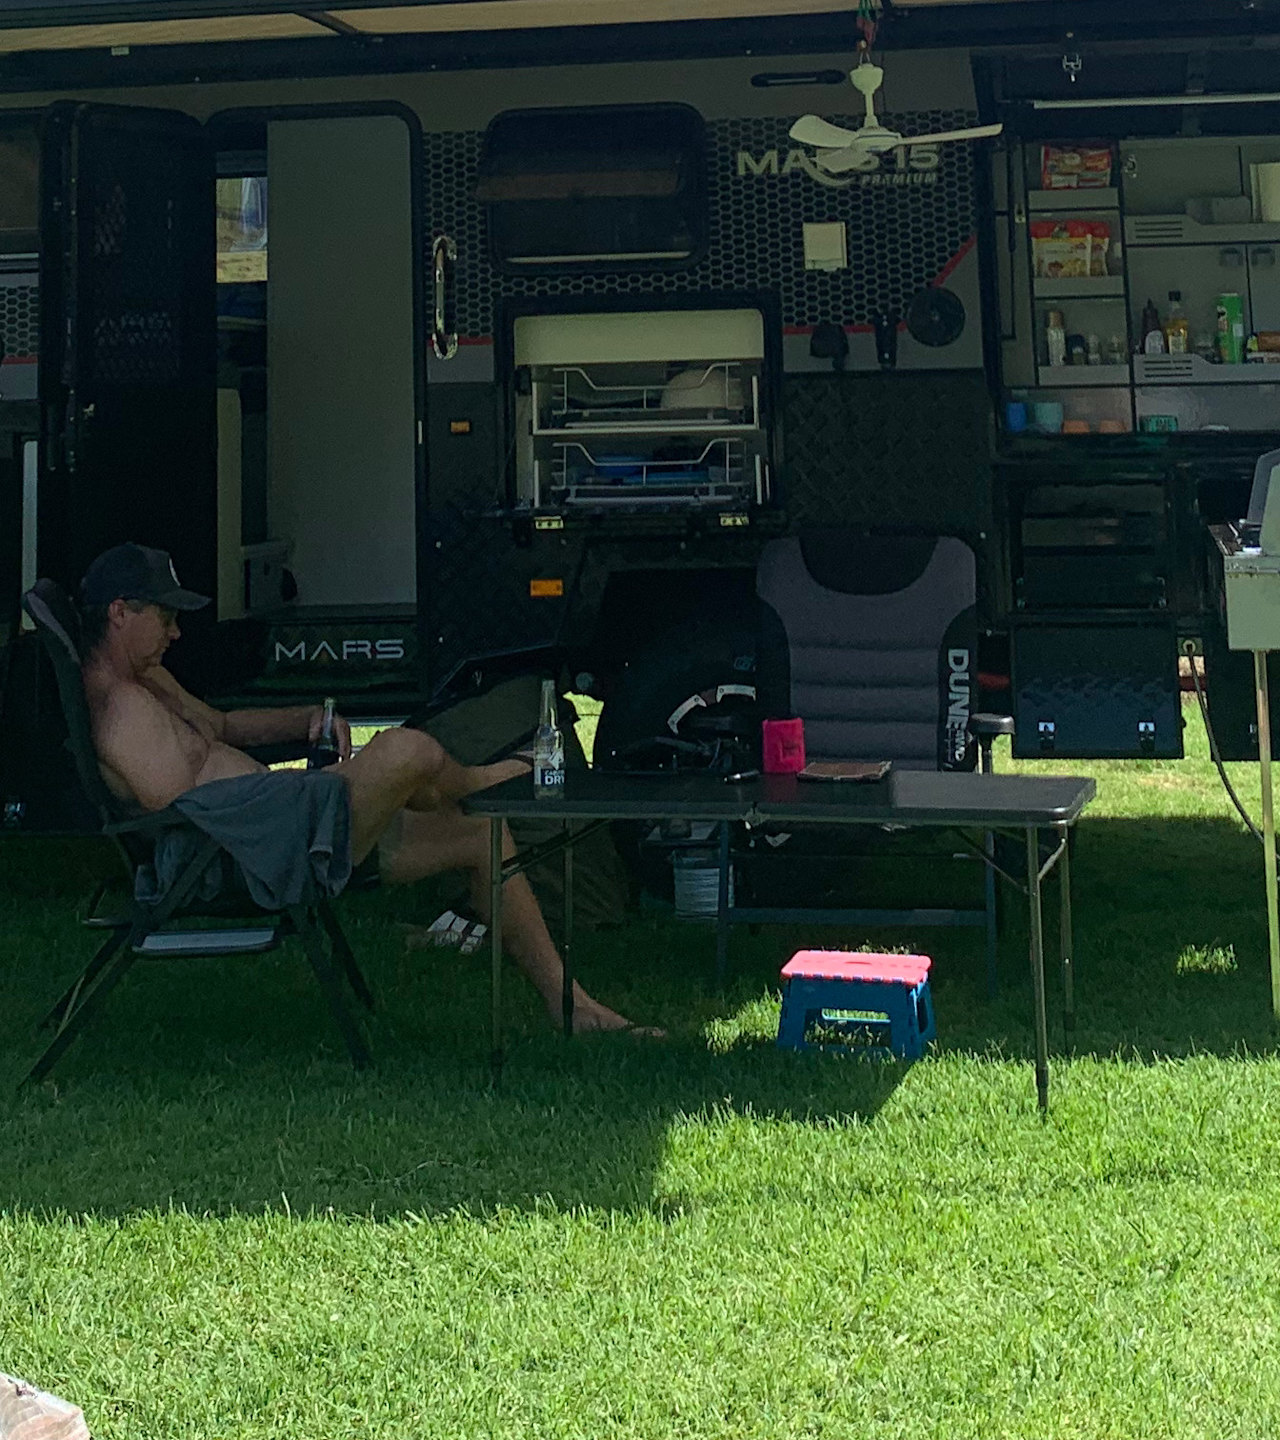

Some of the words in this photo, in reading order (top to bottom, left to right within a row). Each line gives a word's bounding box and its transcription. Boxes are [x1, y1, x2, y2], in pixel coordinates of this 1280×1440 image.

[861, 172, 937, 186] PREMIUM
[275, 638, 405, 662] MARS
[945, 648, 970, 730] DUNE
